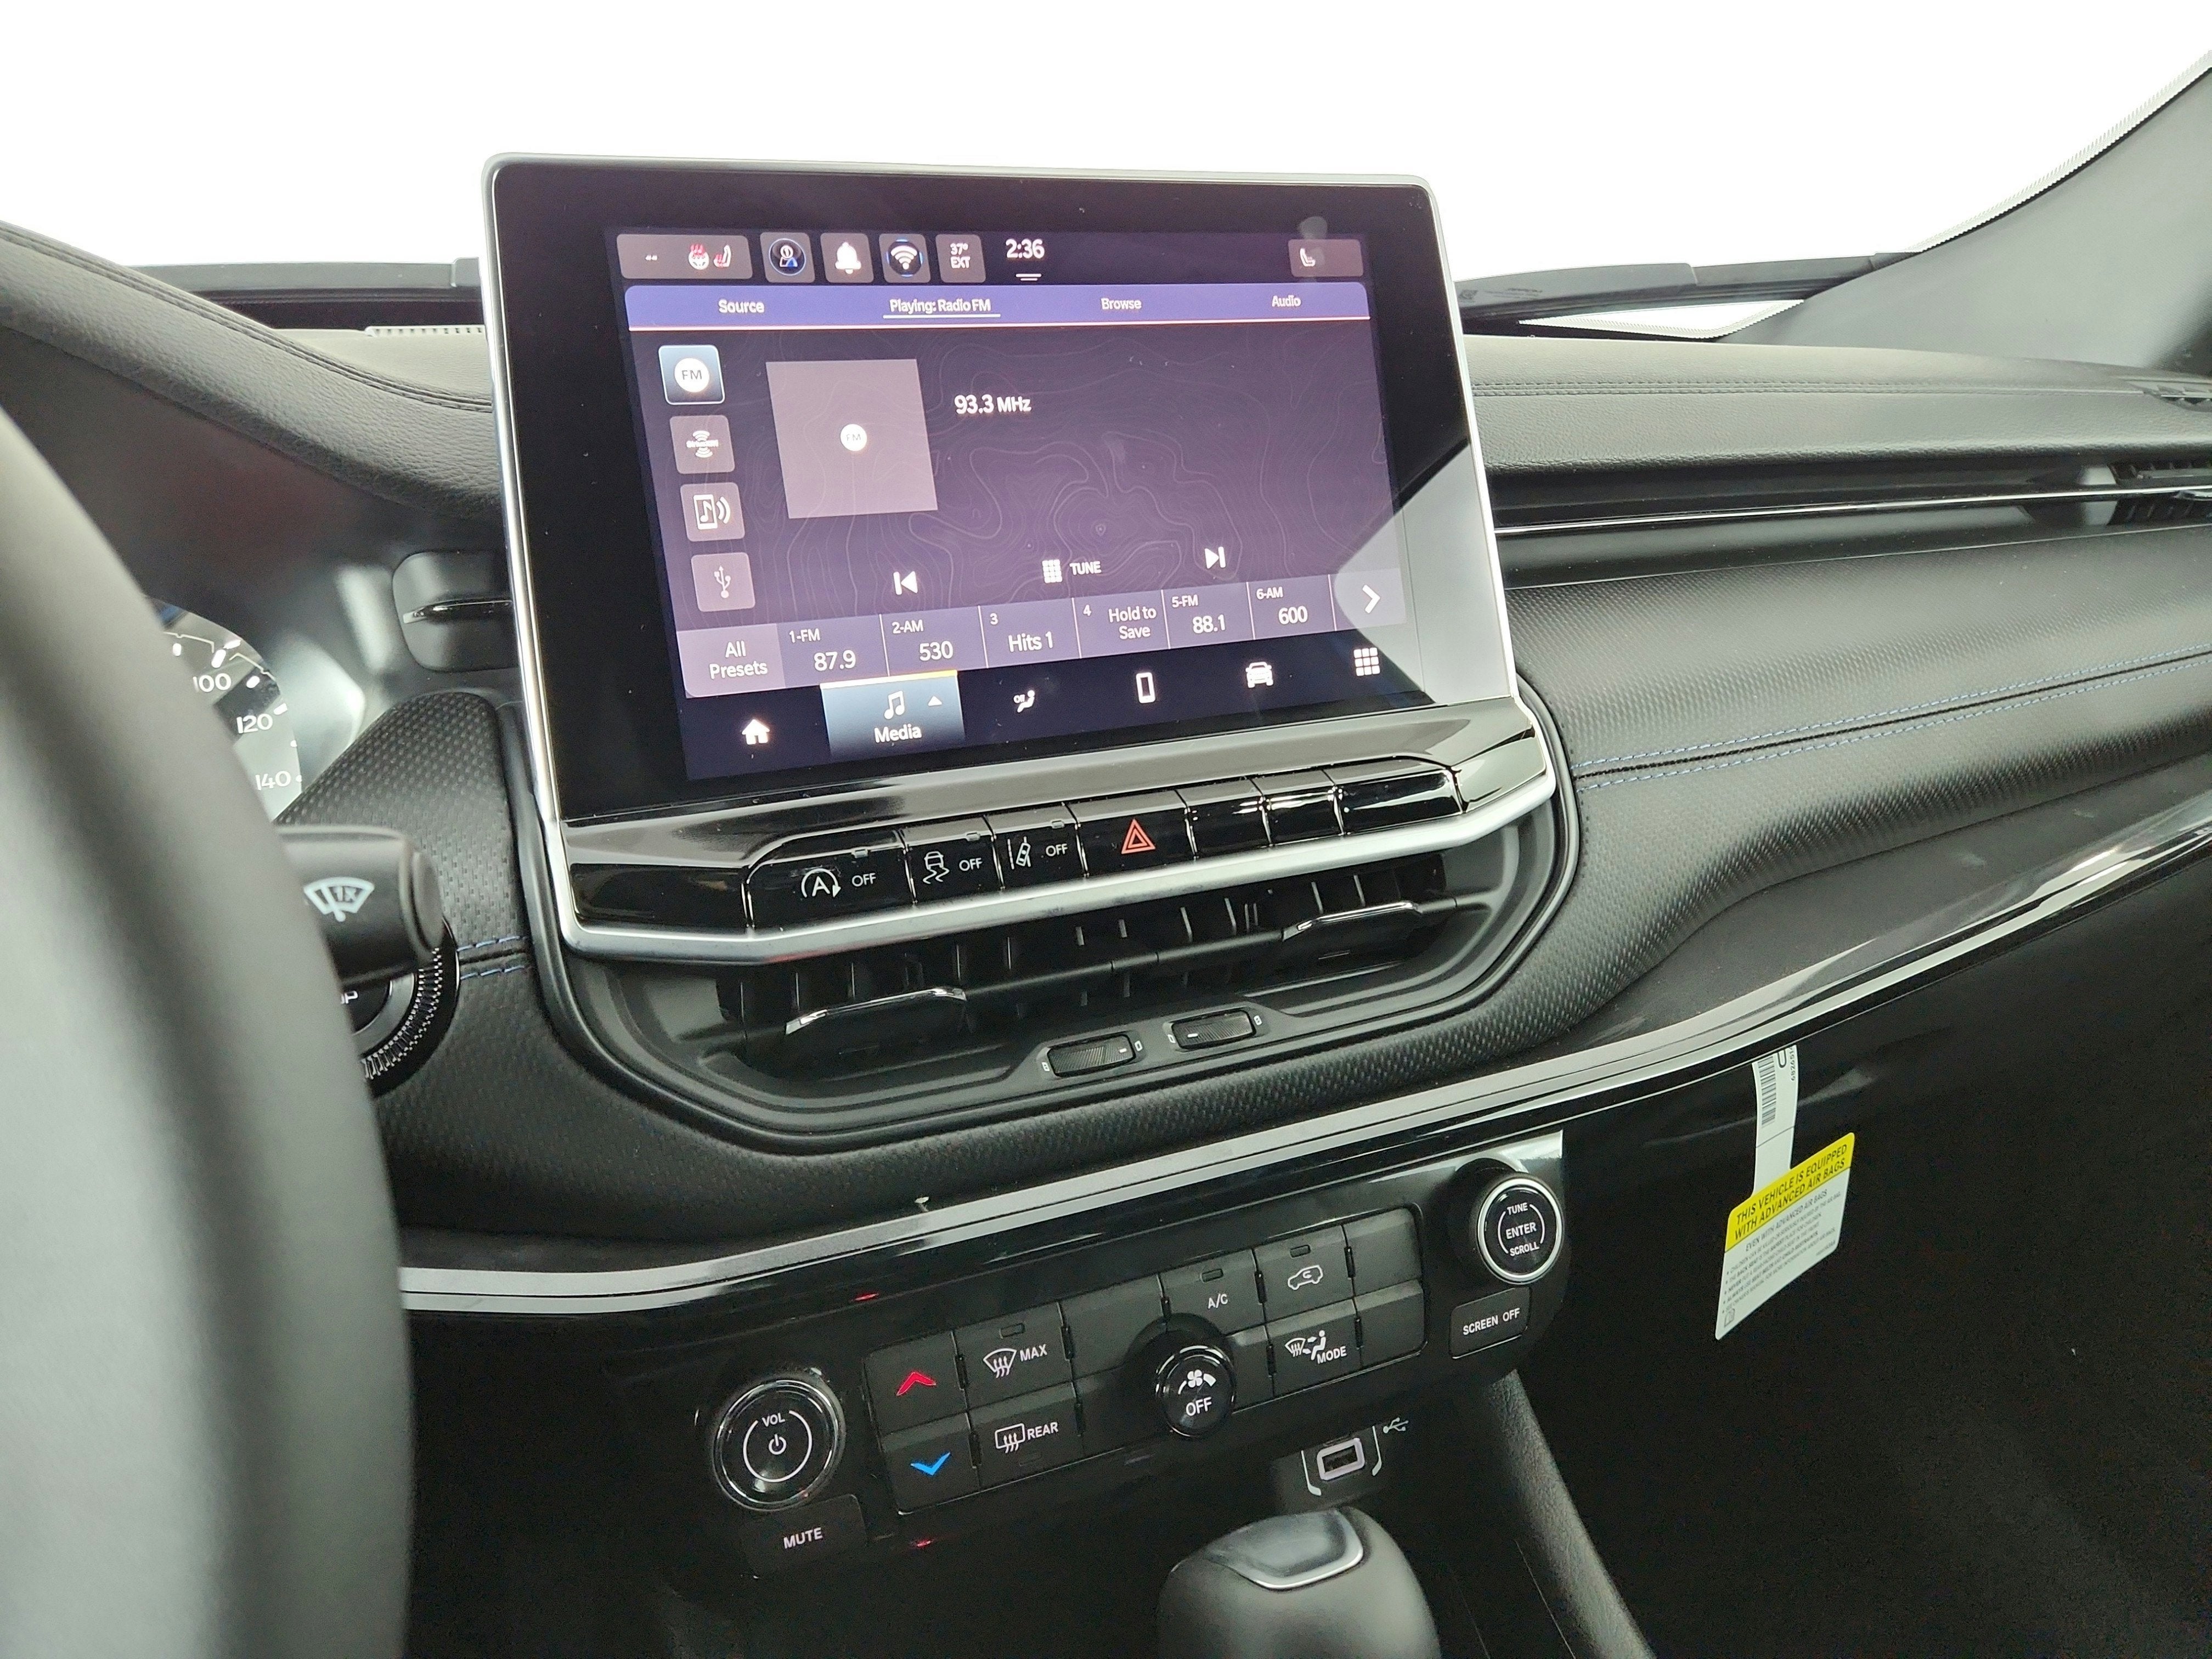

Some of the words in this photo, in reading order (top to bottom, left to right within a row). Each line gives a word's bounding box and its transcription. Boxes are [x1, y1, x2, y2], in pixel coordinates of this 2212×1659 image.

[1006, 239, 1045, 259] 2:36
[950, 256, 970, 268] EXT
[718, 300, 765, 313] Source
[890, 298, 935, 312] Playing:
[938, 298, 970, 311] Radio
[972, 298, 991, 311] FM
[1101, 297, 1142, 309] Browse
[1272, 295, 1301, 307] Audio
[681, 370, 702, 380] FM
[955, 395, 994, 414] 93.3
[997, 396, 1031, 412] MHz
[1070, 561, 1102, 575] TUNE
[1172, 595, 1198, 608] 5-FM
[1256, 586, 1283, 600] 6-AM
[990, 613, 998, 625] 3
[1084, 605, 1091, 617] 4
[1109, 606, 1140, 623] Hold
[1142, 606, 1156, 620] to
[1278, 606, 1307, 625] 600
[892, 620, 924, 635] 2-AM
[1119, 625, 1150, 640] Save
[1192, 614, 1226, 634] 88.1
[789, 629, 821, 643] 1-FM
[1008, 634, 1042, 652] Hits
[1046, 631, 1054, 648] 1
[725, 641, 746, 658] All
[919, 641, 953, 661] 530
[814, 650, 856, 672] 87.9
[709, 661, 768, 679] Presets
[193, 673, 232, 692] 100
[236, 714, 273, 733] 120
[874, 725, 922, 743] Media
[255, 771, 291, 791] 140
[1045, 843, 1068, 857] OFF
[959, 857, 983, 872] OFF
[851, 873, 877, 887] OFF
[1736, 1203, 1756, 1224] THIS
[1758, 1176, 1796, 1206] VEHICLE
[1796, 1171, 1804, 1184] IS
[1805, 1144, 1847, 1177] EQUIPPED
[1735, 1217, 1757, 1240] WITH
[1759, 1184, 1805, 1224] ADVANCED
[1807, 1173, 1821, 1191] AIR
[1822, 1158, 1845, 1180] BAGS
[1507, 1202, 1528, 1214] TUNE
[1745, 1236, 1759, 1250] EVEN
[1760, 1226, 1774, 1239] WITH
[1775, 1205, 1803, 1229] ADVANCED
[1803, 1199, 1813, 1209] AIR
[1813, 1189, 1827, 1203] BAGS
[1505, 1221, 1537, 1239] ENTER
[1509, 1242, 1539, 1256] SCROLL
[1207, 1293, 1228, 1309] A/C
[1463, 1316, 1499, 1335] SCREEN
[1502, 1307, 1521, 1323] OFF
[1019, 1344, 1048, 1363] MAX
[1317, 1346, 1347, 1364] MODE
[1186, 1397, 1212, 1416] OFF
[761, 1413, 786, 1427] VOL
[1027, 1421, 1059, 1440] REAR
[783, 1527, 823, 1549] MUTE
